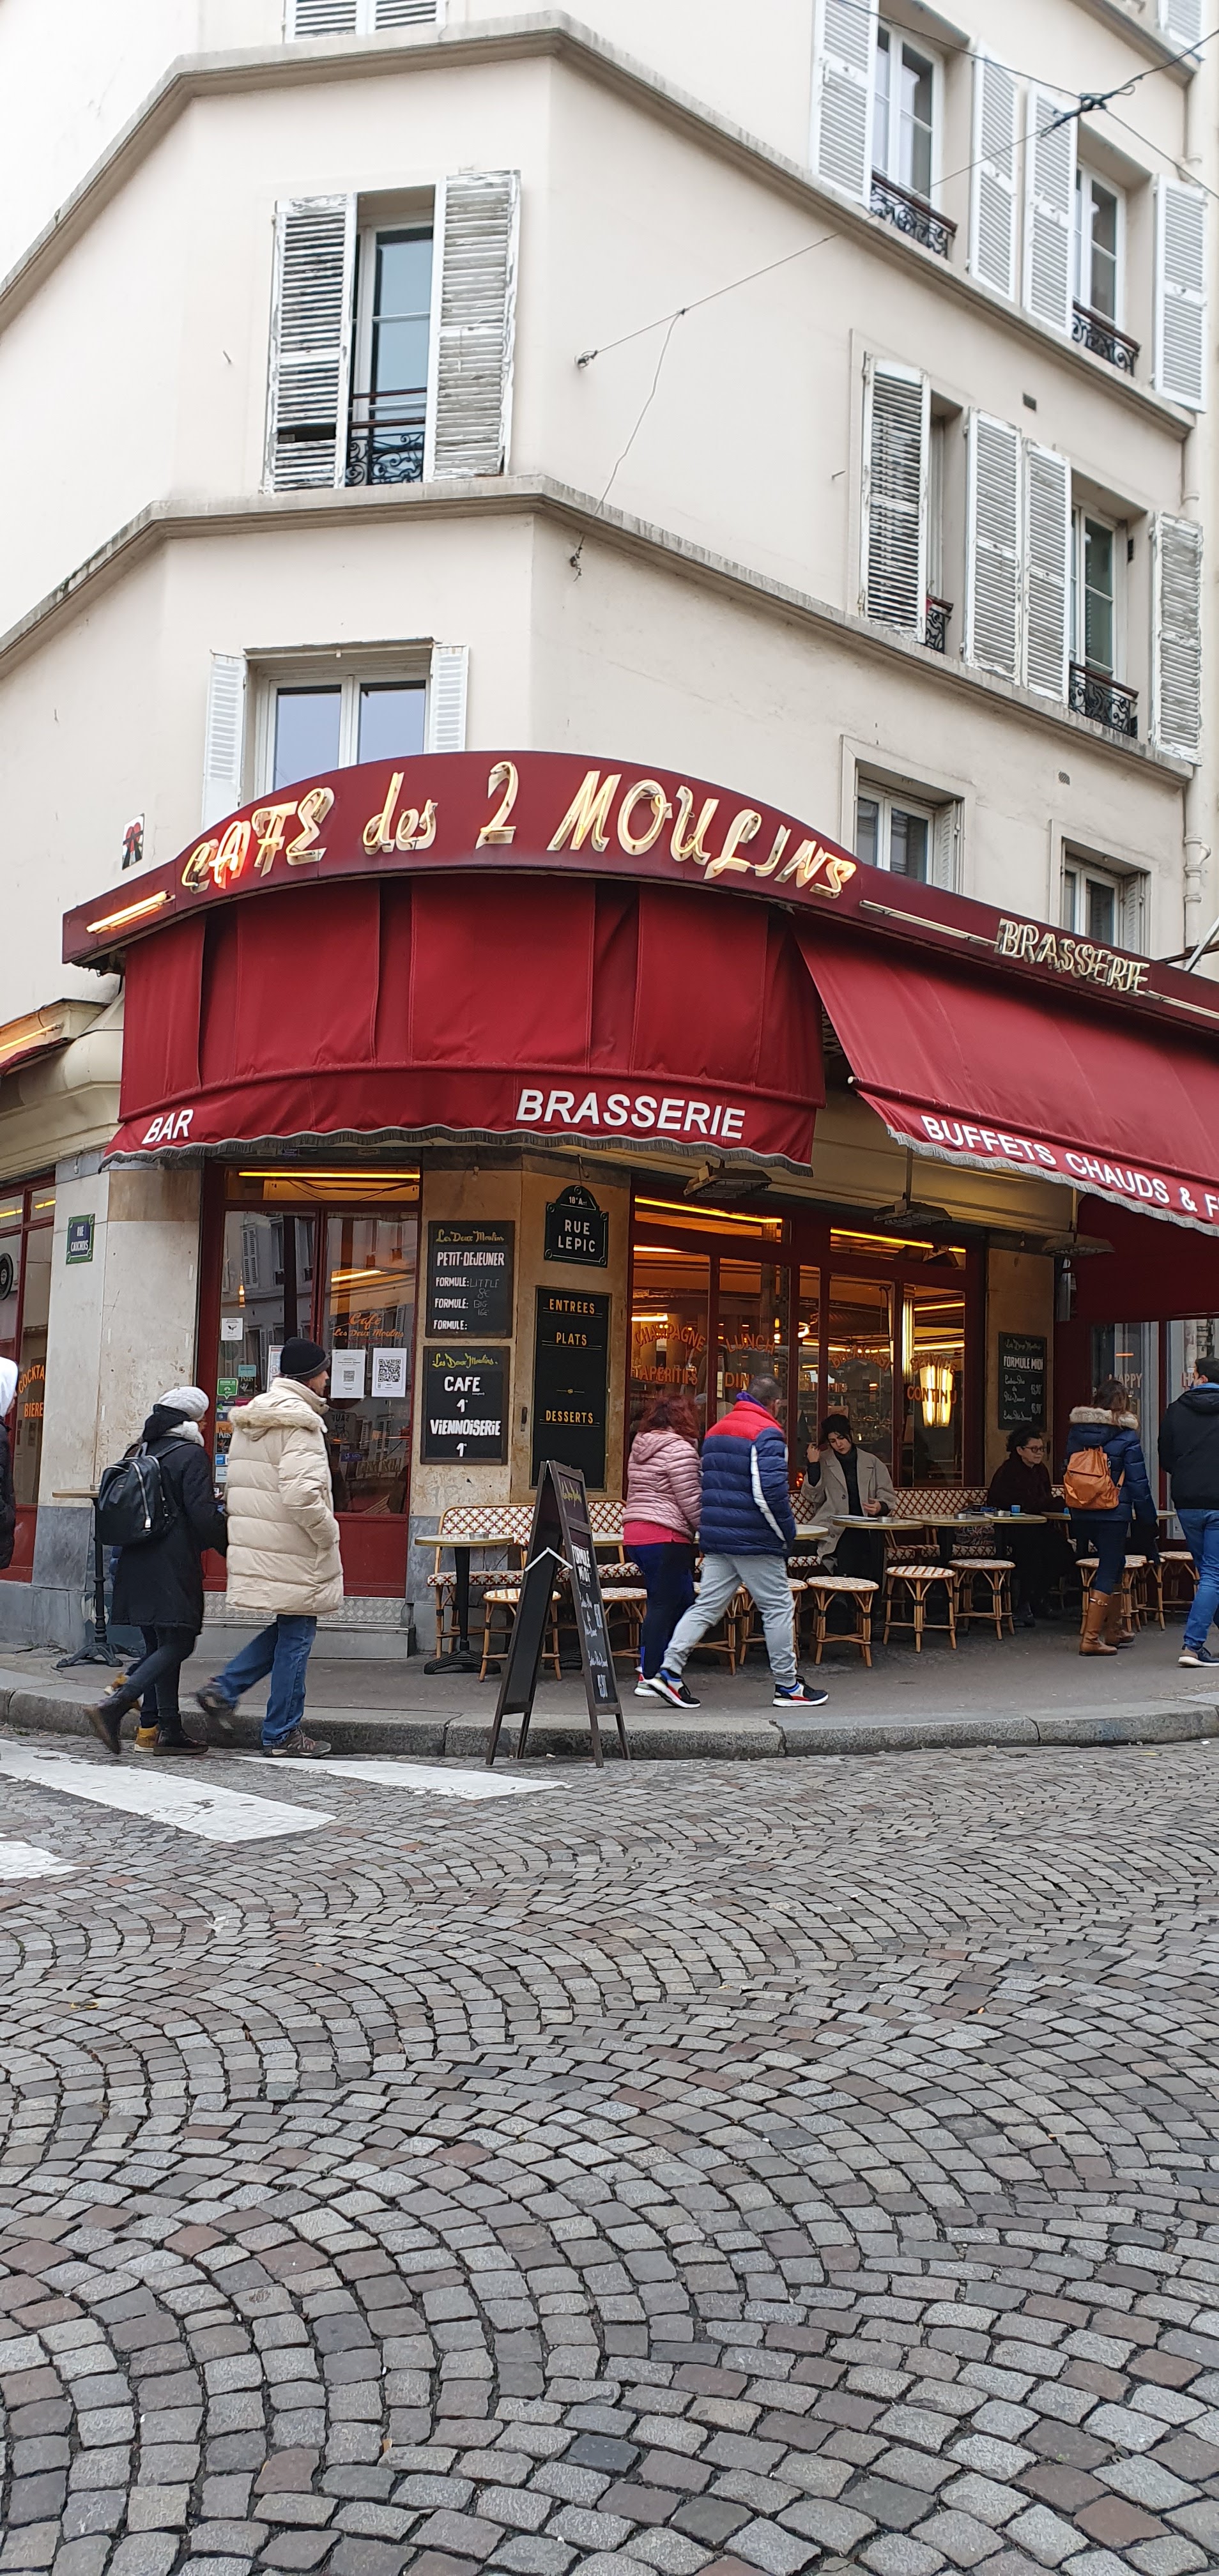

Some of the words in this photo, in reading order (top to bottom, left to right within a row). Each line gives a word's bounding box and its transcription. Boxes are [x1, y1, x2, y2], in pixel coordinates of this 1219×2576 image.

[364, 771, 438, 855] des
[475, 760, 519, 850] 2
[546, 769, 857, 899] MOULINS
[997, 918, 1150, 995] BRASSERIE
[516, 1089, 746, 1140] BRASSERIE
[141, 1108, 194, 1145] BAR
[921, 1114, 1057, 1166] BUFFETS
[1065, 1151, 1170, 1204] CHAUDS
[1179, 1185, 1198, 1213] &
[1204, 1193, 1219, 1218] F
[564, 1219, 590, 1235] RUE
[558, 1235, 595, 1253] LEPIC
[436, 1276, 470, 1287] FORMULE:
[434, 1298, 468, 1309] FORMULE:
[473, 1300, 488, 1308] BIG
[433, 1319, 468, 1330] FORMULE:
[556, 1331, 587, 1347] PLATS
[634, 1323, 706, 1353] CHAMPAGNE
[726, 1333, 775, 1356] LUNCH
[1003, 1355, 1031, 1370] FORMULE
[19, 1364, 45, 1394] COCKTA
[444, 1376, 481, 1392] CAFE
[724, 1372, 755, 1388] DIN
[1108, 1373, 1142, 1389] APPY
[907, 1384, 958, 1405] CONTINU
[546, 1409, 594, 1424] DESSERTS
